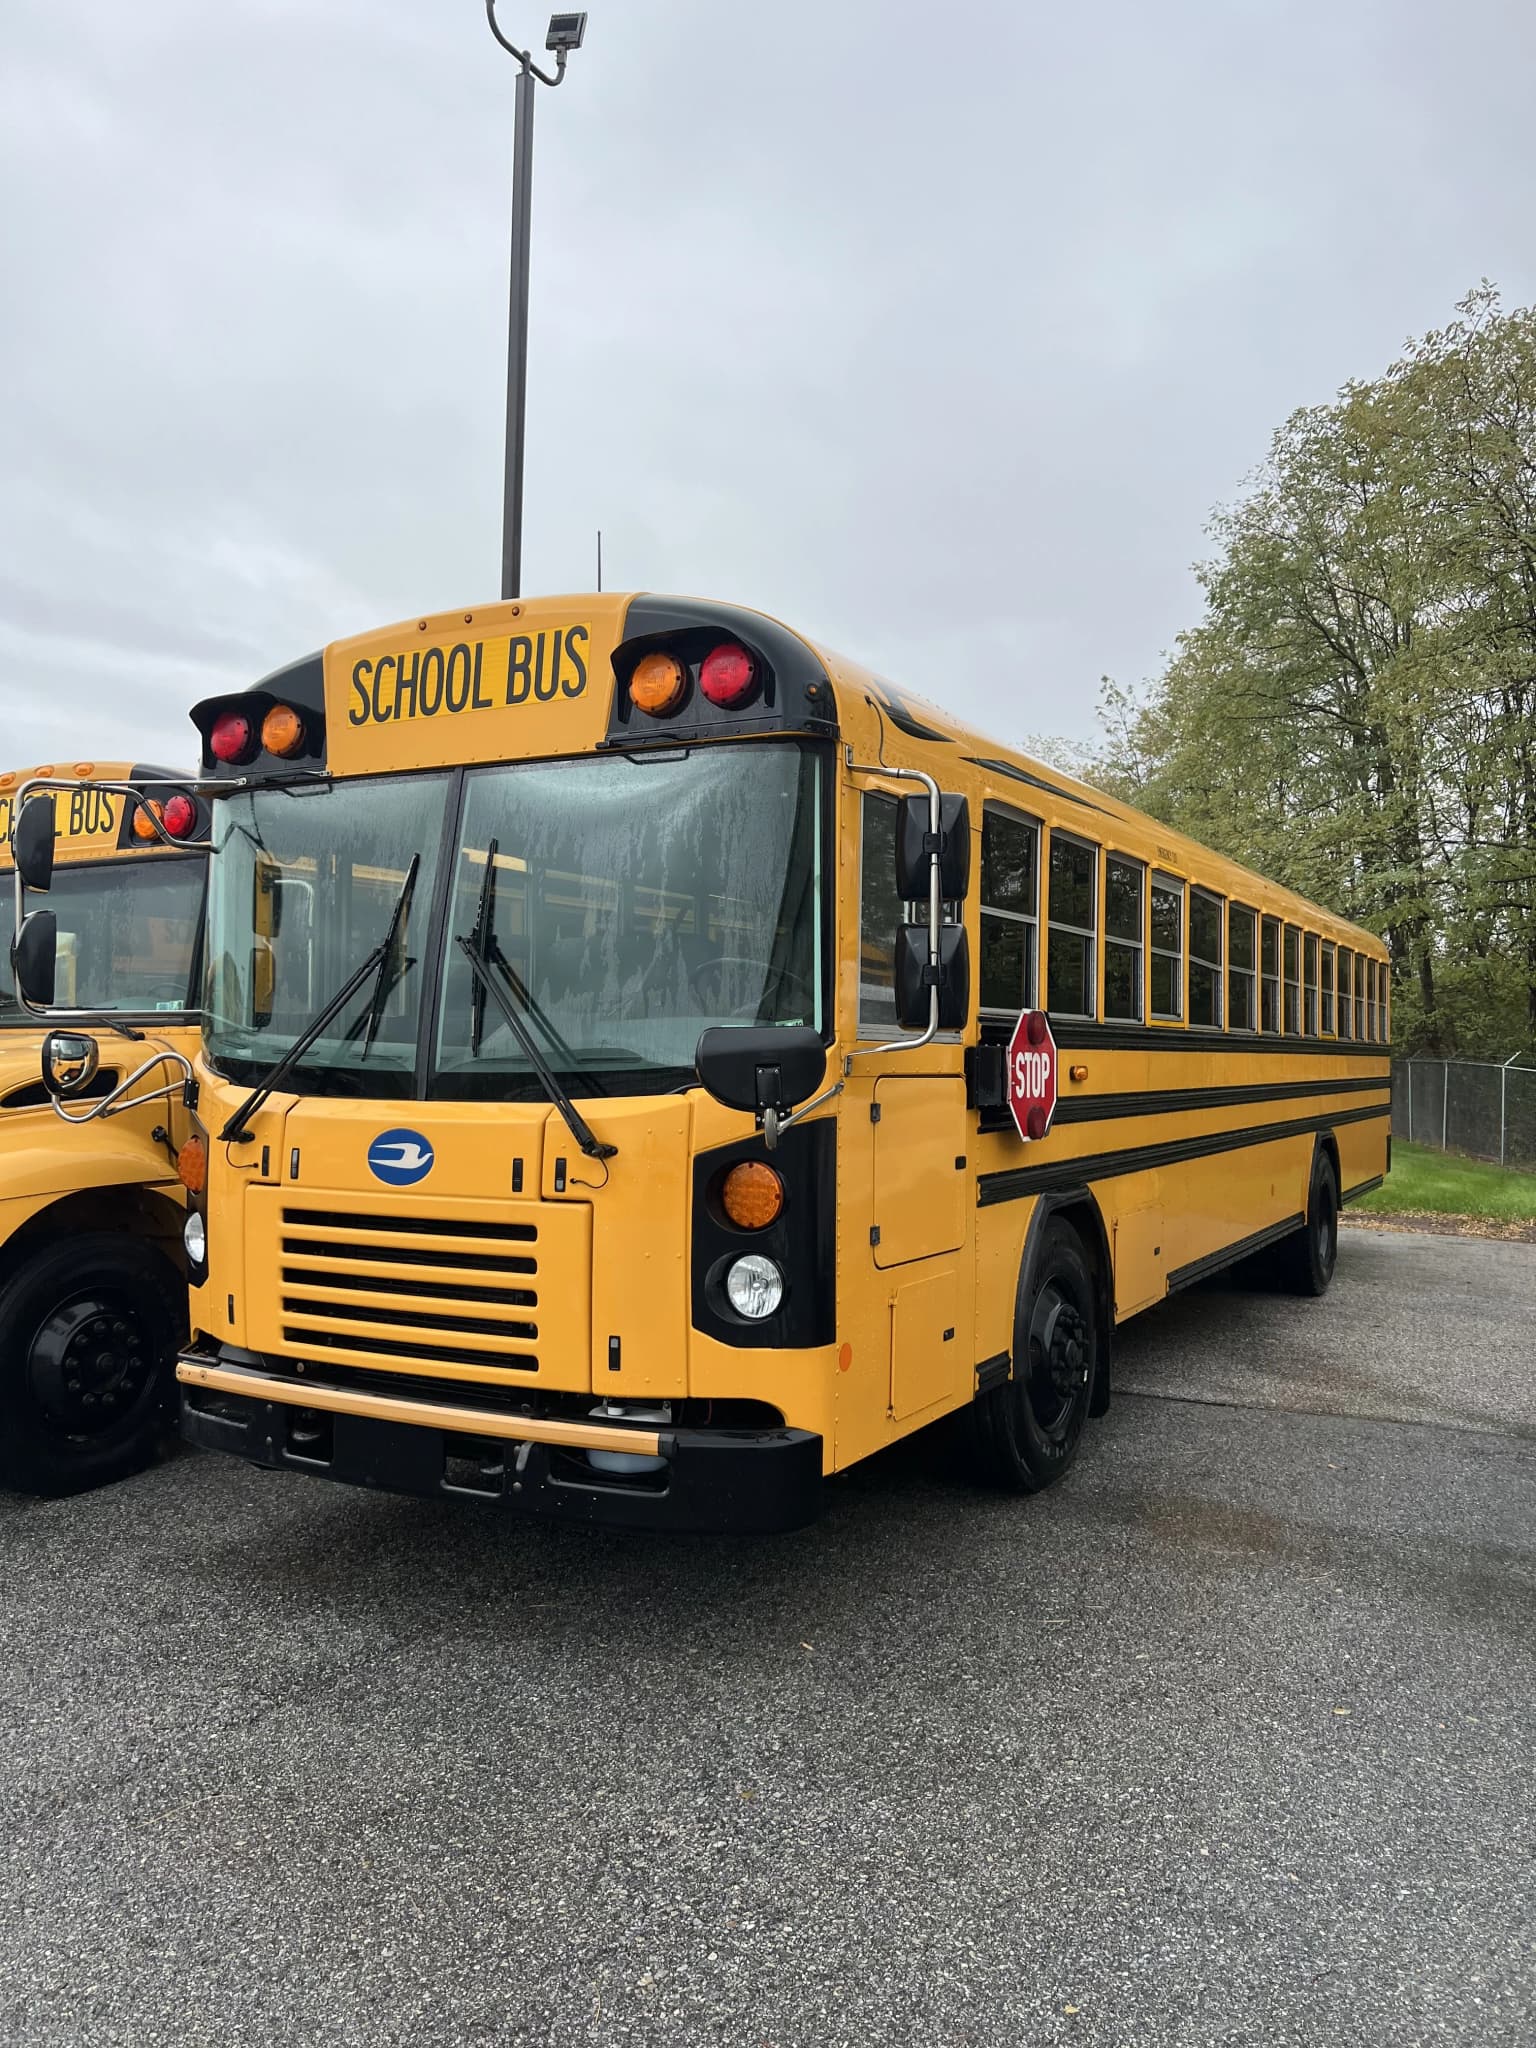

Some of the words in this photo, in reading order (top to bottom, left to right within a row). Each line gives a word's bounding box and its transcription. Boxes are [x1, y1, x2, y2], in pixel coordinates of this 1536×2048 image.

[349, 642, 493, 726] SCHOOL
[505, 625, 589, 705] BUS
[69, 789, 115, 835] BUS
[1015, 1051, 1051, 1099] STOP
